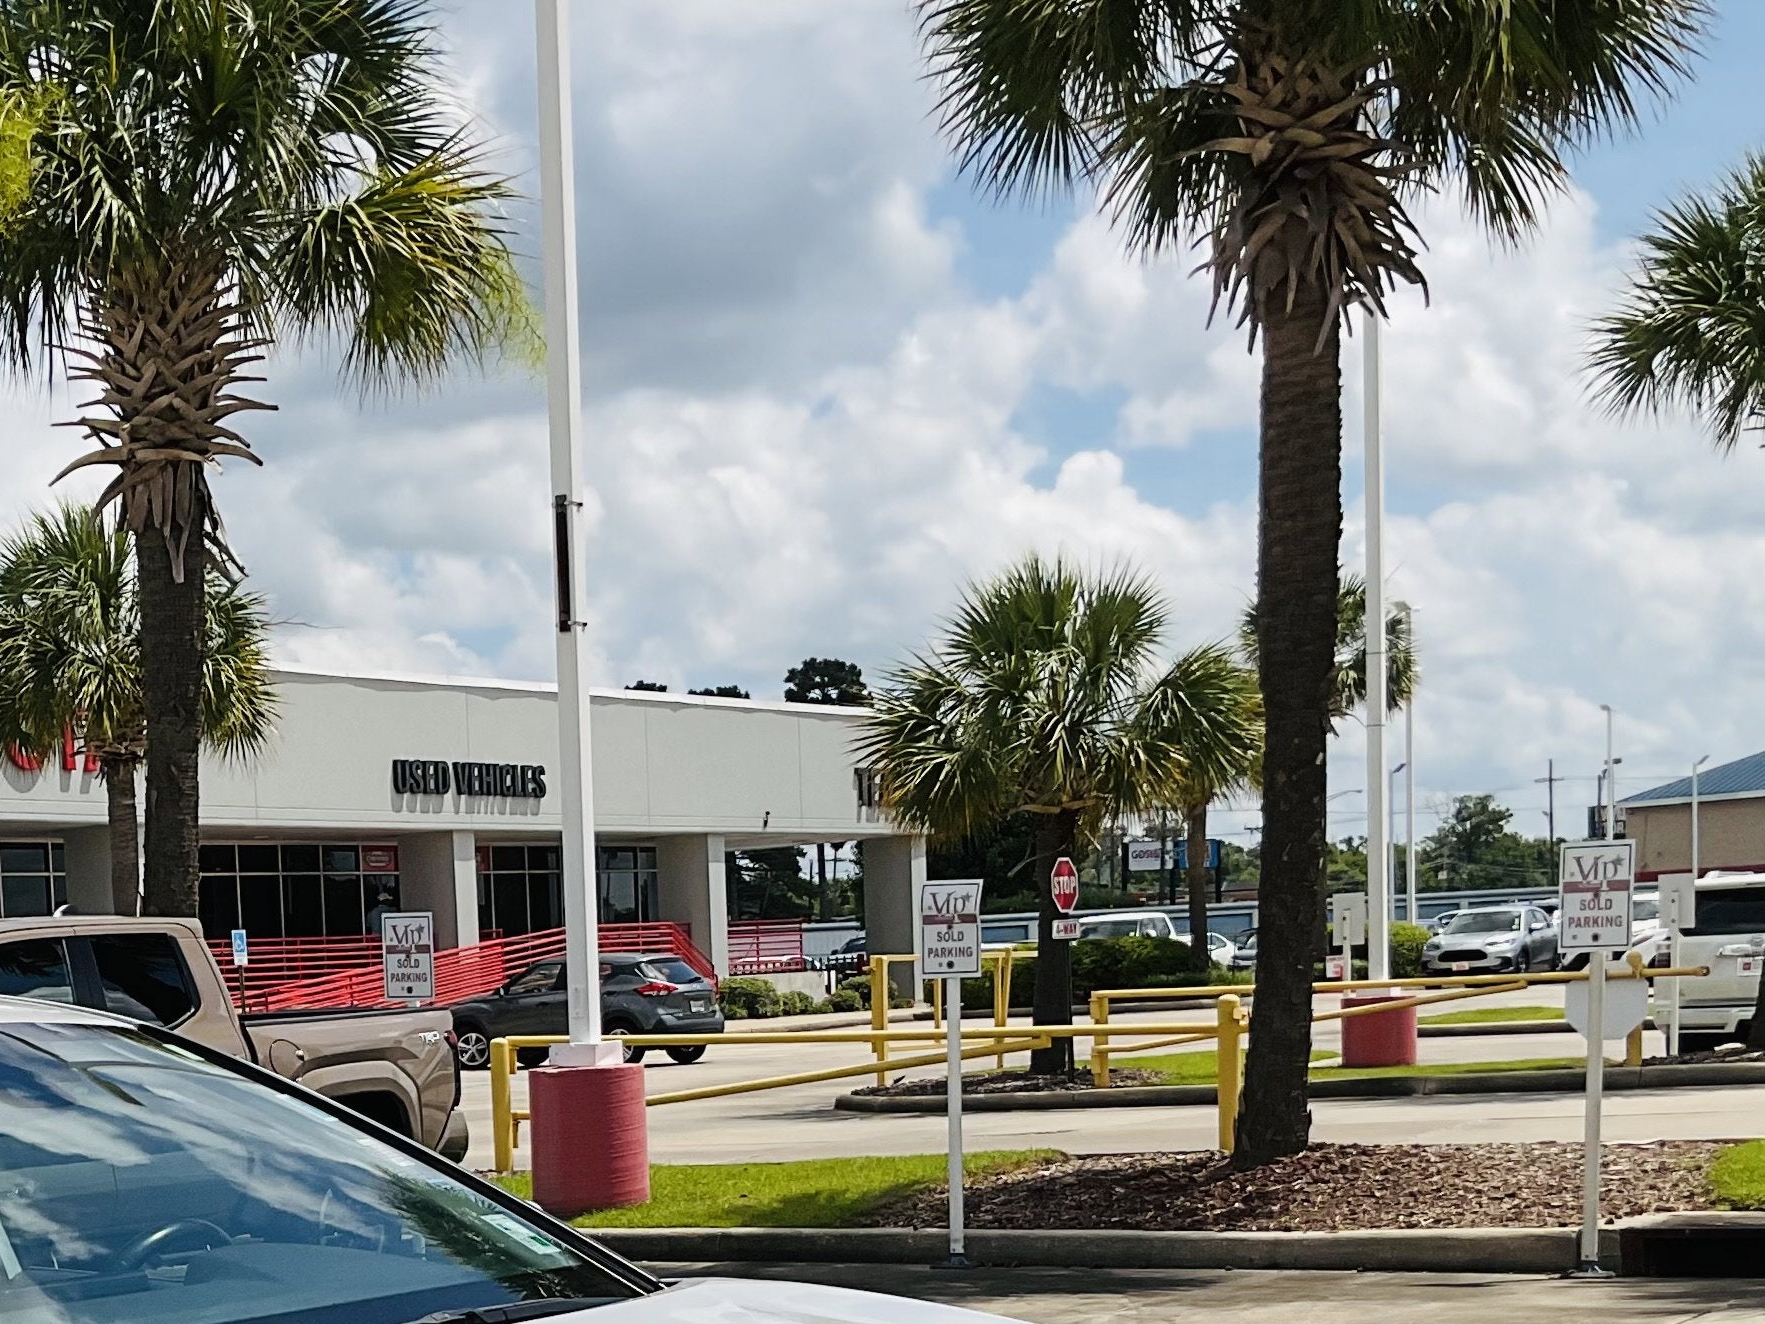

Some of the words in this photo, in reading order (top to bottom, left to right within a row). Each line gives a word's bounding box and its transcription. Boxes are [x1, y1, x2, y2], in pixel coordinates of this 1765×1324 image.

[392, 759, 451, 795] USED
[451, 761, 547, 798] VEHICLES
[1053, 875, 1076, 895] STOP
[1579, 898, 1613, 912] SOLD
[1568, 915, 1623, 929] PARKING
[936, 930, 965, 943] SOLD
[927, 946, 973, 959] PARKING
[396, 958, 420, 969] SOLD
[390, 972, 428, 983] PARKING
